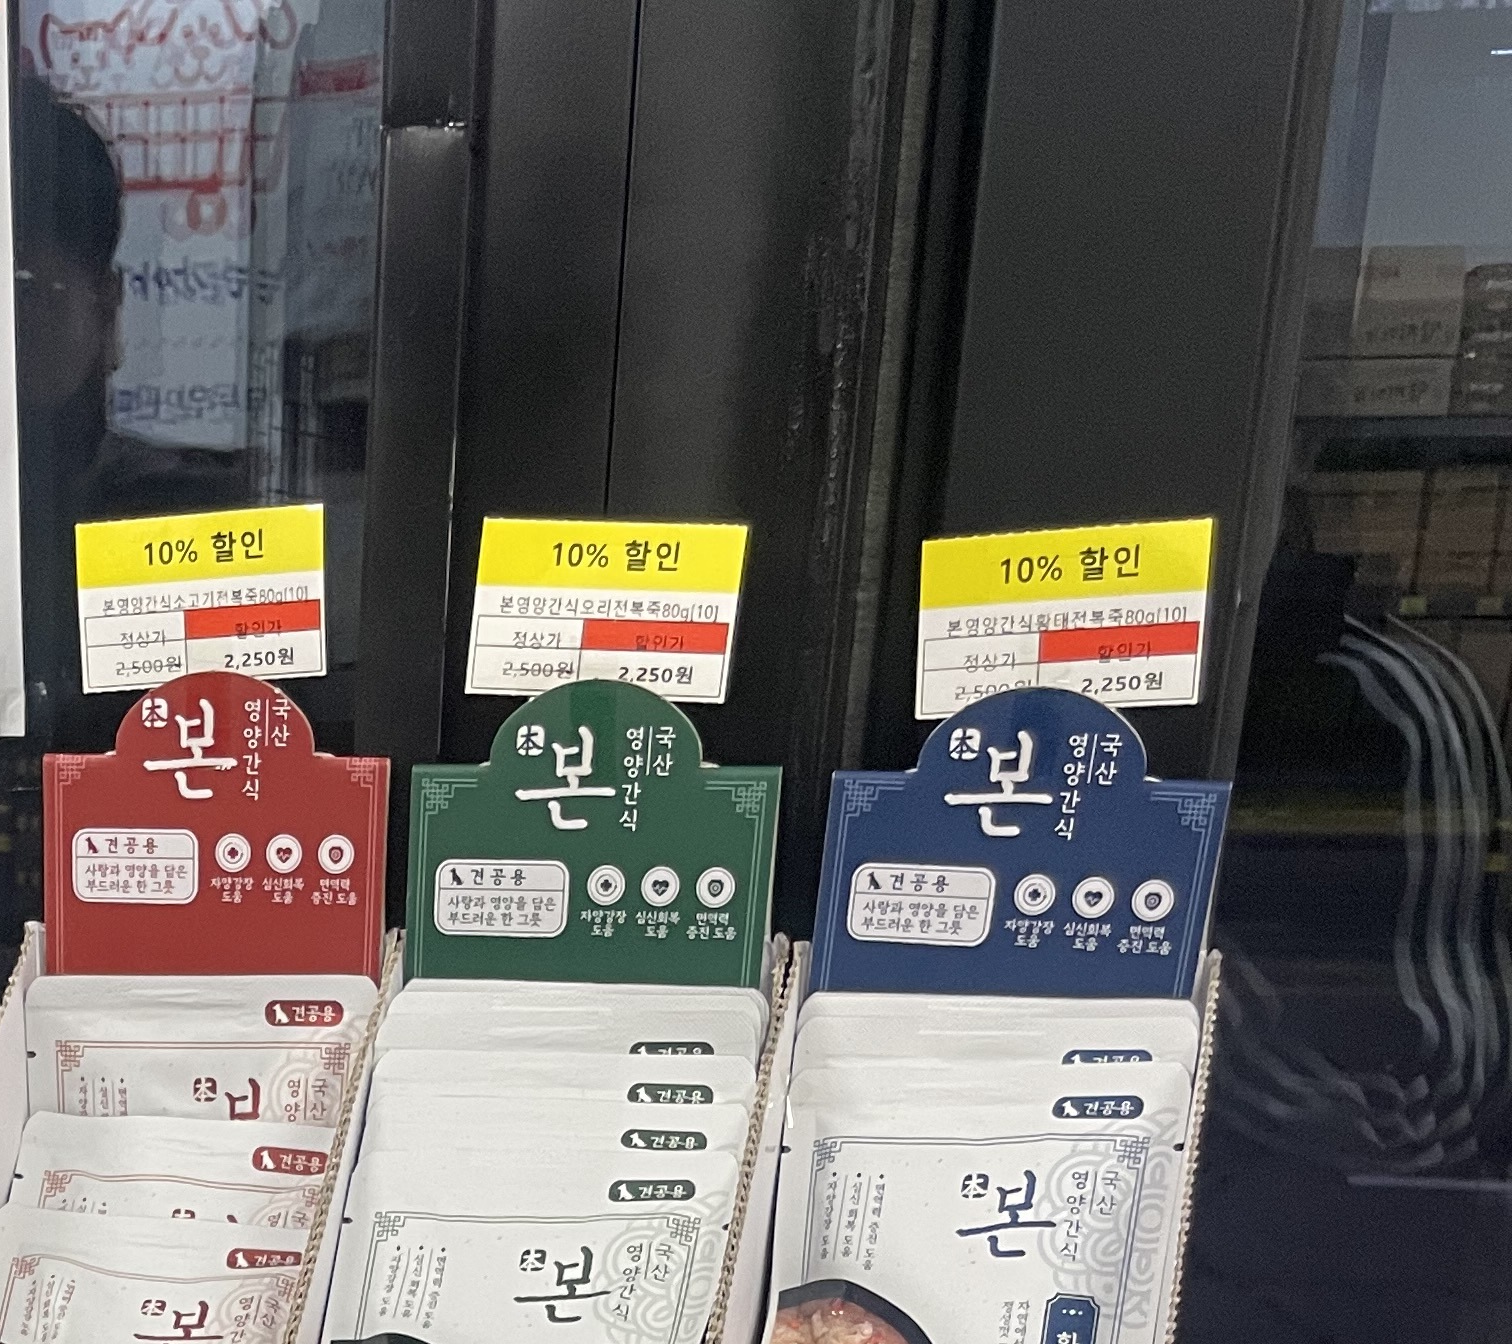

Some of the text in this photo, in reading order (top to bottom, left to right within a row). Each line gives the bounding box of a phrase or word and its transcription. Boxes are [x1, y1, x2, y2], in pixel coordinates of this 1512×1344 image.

[552, 540, 681, 572] 10% 할인
[1000, 543, 1141, 585] 10% 할인
[224, 647, 295, 671] 2,250원
[513, 632, 561, 650] 정상가
[618, 665, 694, 685] 2,250원
[1081, 672, 1163, 695] 2,250원
[271, 698, 292, 748] 국산
[143, 698, 238, 800] 본
[242, 699, 263, 801] 영양간식
[652, 726, 676, 777] 국산
[1094, 735, 1123, 786] 국산
[515, 725, 616, 831] 본
[619, 726, 645, 832] 영양간식
[944, 730, 1054, 837] 본
[1053, 733, 1090, 841] 영양간식
[956, 1169, 1057, 1258] 본
[1058, 1170, 1090, 1262] 영양간식
[1097, 1170, 1122, 1216] 국산
[513, 1245, 612, 1323] 본
